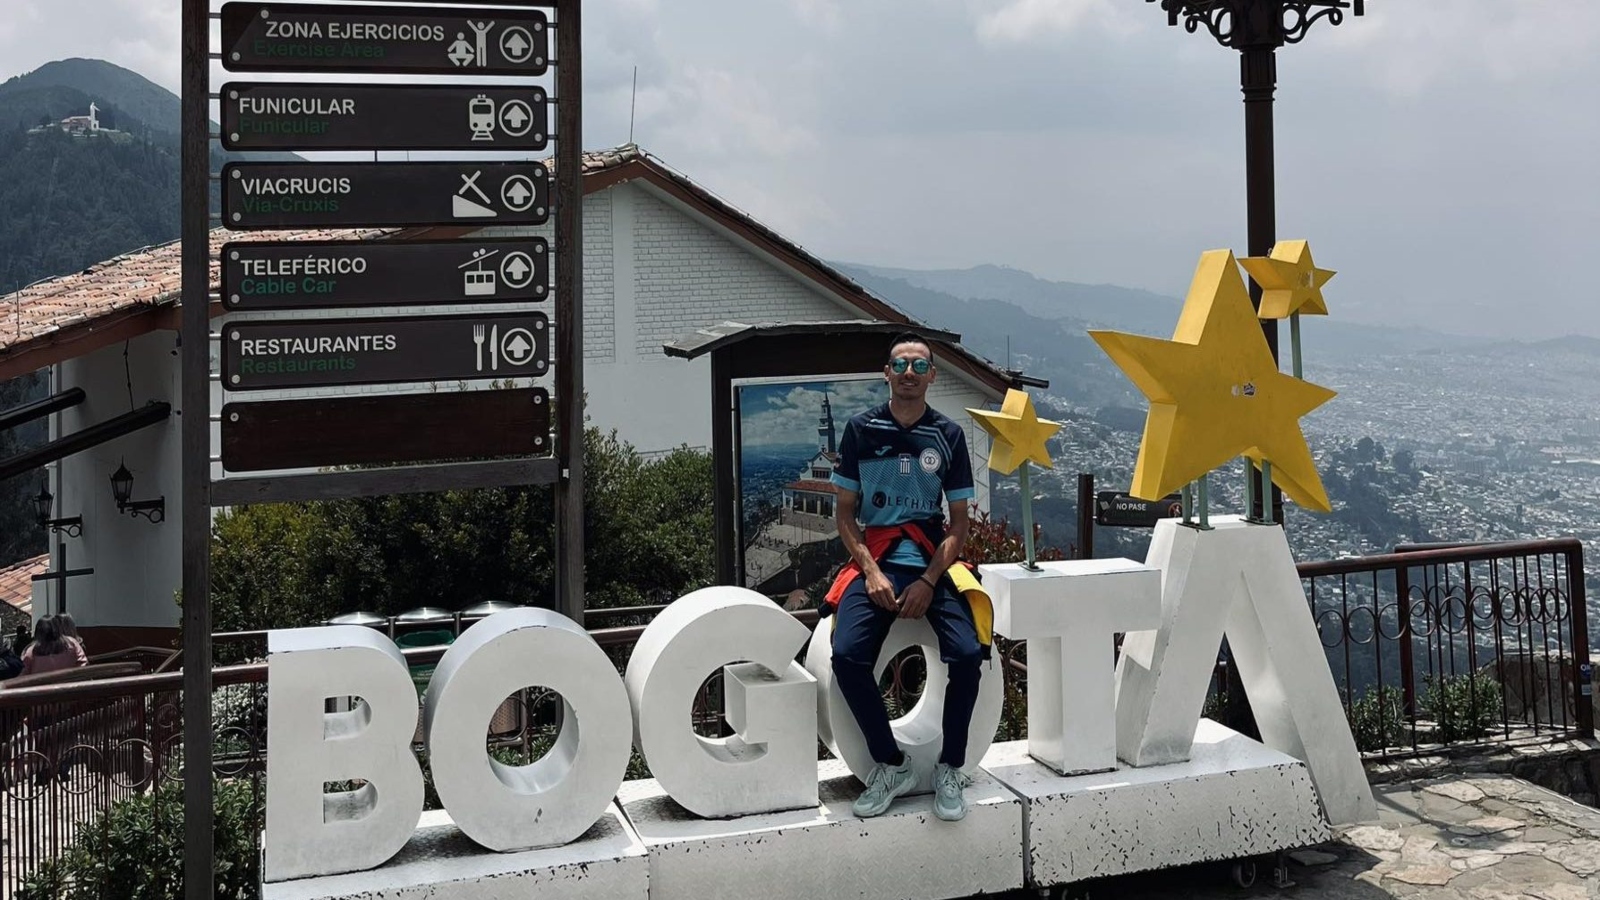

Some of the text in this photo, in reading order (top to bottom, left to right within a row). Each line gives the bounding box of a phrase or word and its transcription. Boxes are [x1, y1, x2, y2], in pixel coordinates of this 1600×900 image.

[265, 21, 444, 41] ZONA EJERCICIOS
[254, 41, 384, 58] Exercise Area
[239, 97, 355, 115] FUNICULAR
[239, 118, 331, 134] Funicular
[241, 177, 351, 195] VIACRUCIS
[242, 197, 340, 214] Via-Cruxis
[240, 255, 366, 275] TELEFÉRICO
[240, 278, 336, 294] Cable Car
[240, 334, 397, 355] RESTAURANTES
[241, 355, 356, 373] Restaurants
[1129, 503, 1147, 511] PASE
